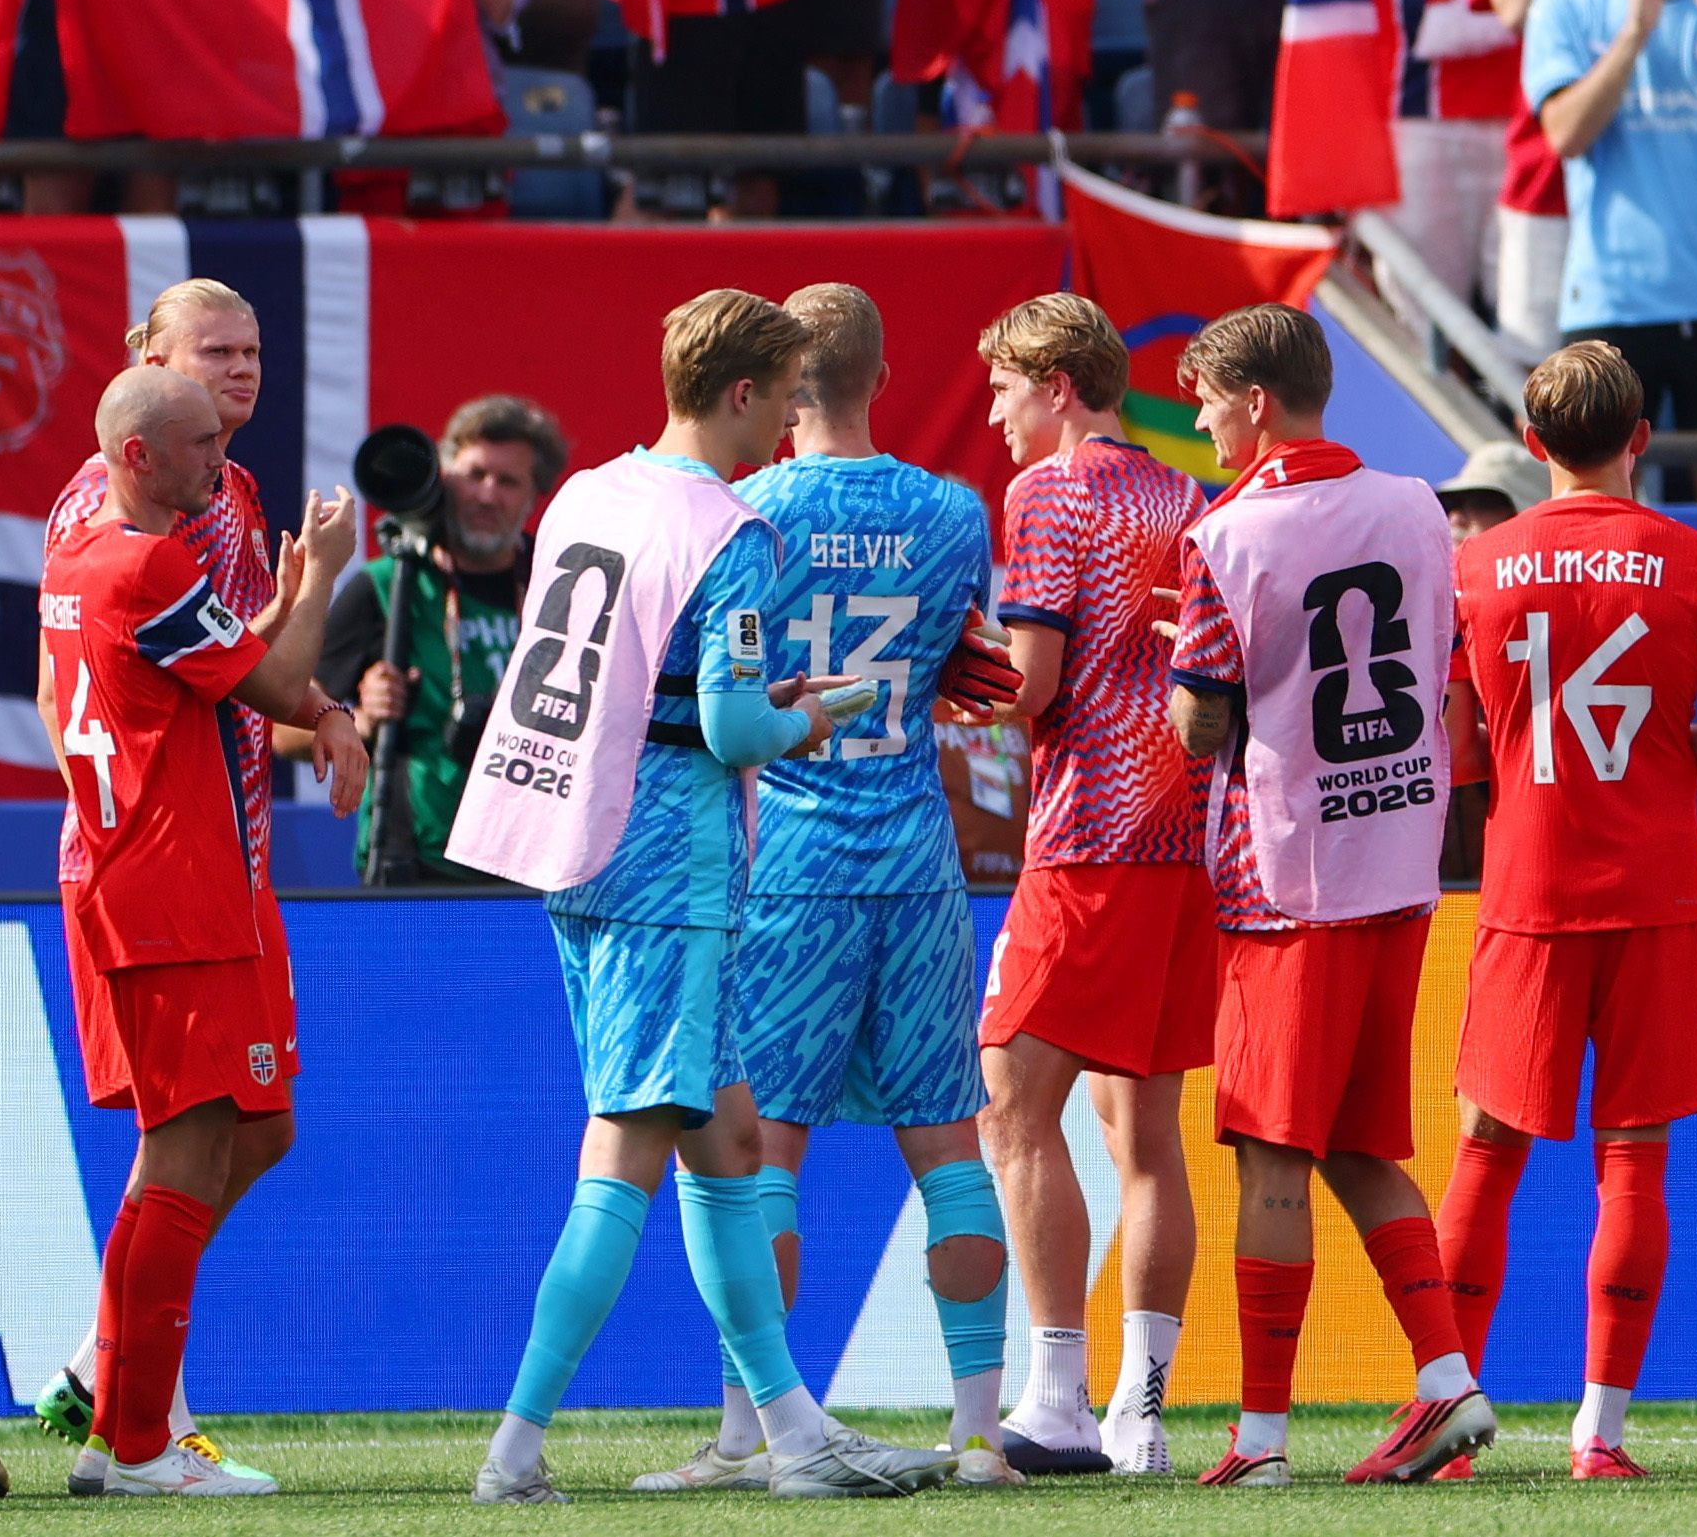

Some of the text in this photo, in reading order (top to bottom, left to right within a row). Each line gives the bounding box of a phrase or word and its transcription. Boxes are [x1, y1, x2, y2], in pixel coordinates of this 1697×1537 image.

[810, 533, 916, 571] SELVIK
[1495, 549, 1665, 590] HOLMGREN
[787, 593, 921, 762] 13
[1505, 610, 1653, 785] 16
[531, 692, 579, 725] FIFA
[47, 654, 118, 830] 4
[496, 731, 555, 760] WORLD
[1341, 719, 1395, 746] FIFA
[483, 752, 574, 800] 2026
[1315, 755, 1433, 793] WORLD CUP
[1320, 777, 1436, 824] 2026
